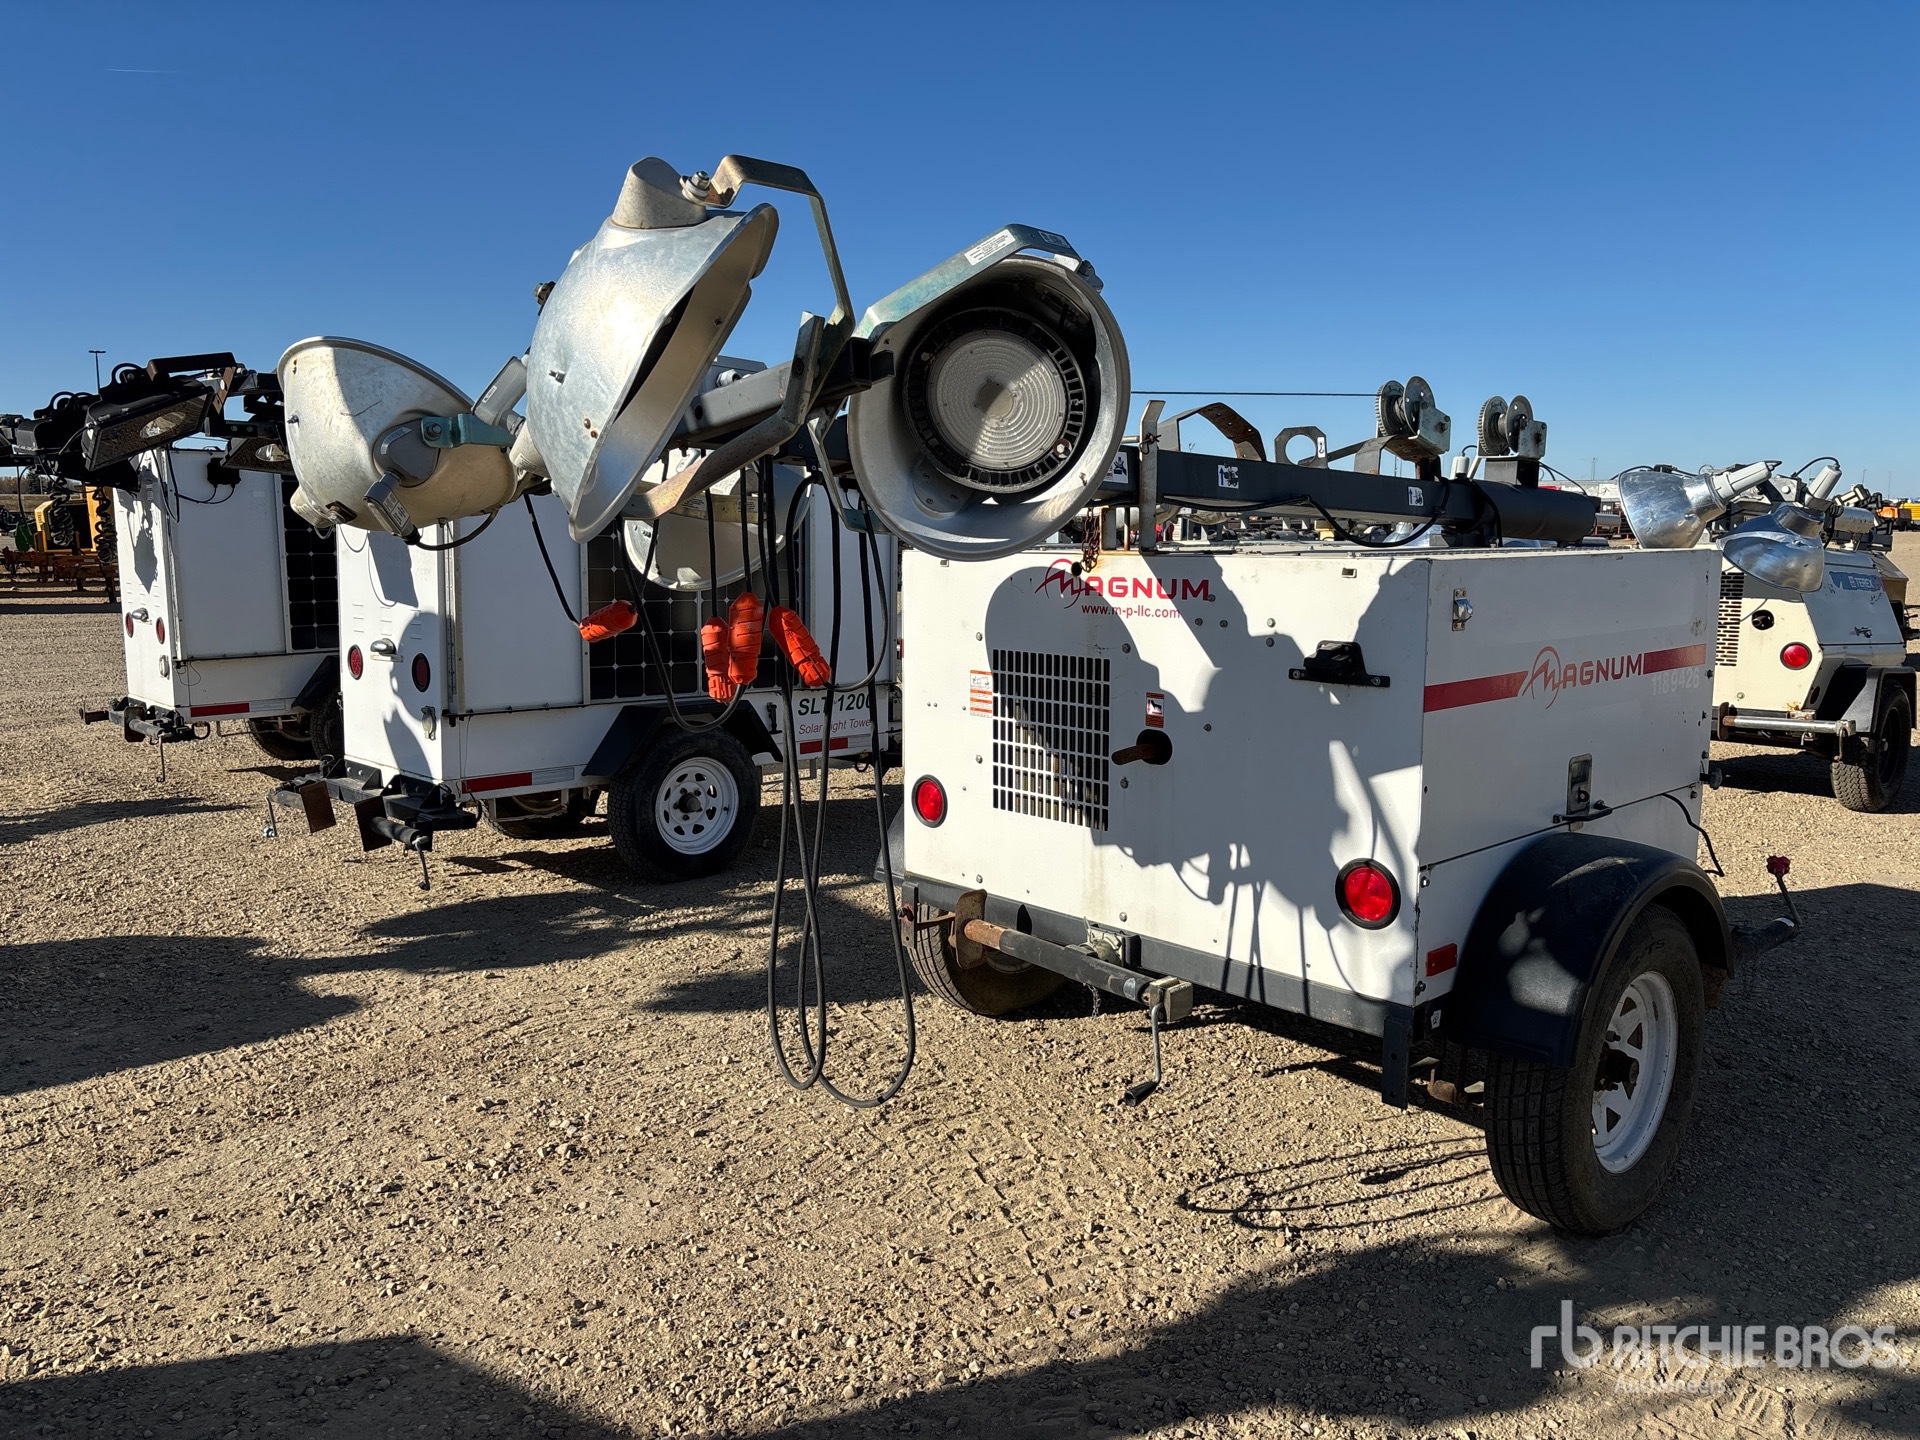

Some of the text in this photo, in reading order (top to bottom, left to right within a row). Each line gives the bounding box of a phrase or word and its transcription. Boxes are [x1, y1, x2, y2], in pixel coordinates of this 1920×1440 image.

[1035, 559, 1209, 609] MAGNUM
[1081, 605, 1181, 618] www.m-p-llc.com
[1522, 645, 1643, 709] MAGNUM
[798, 718, 872, 735] Solar ight Towe
